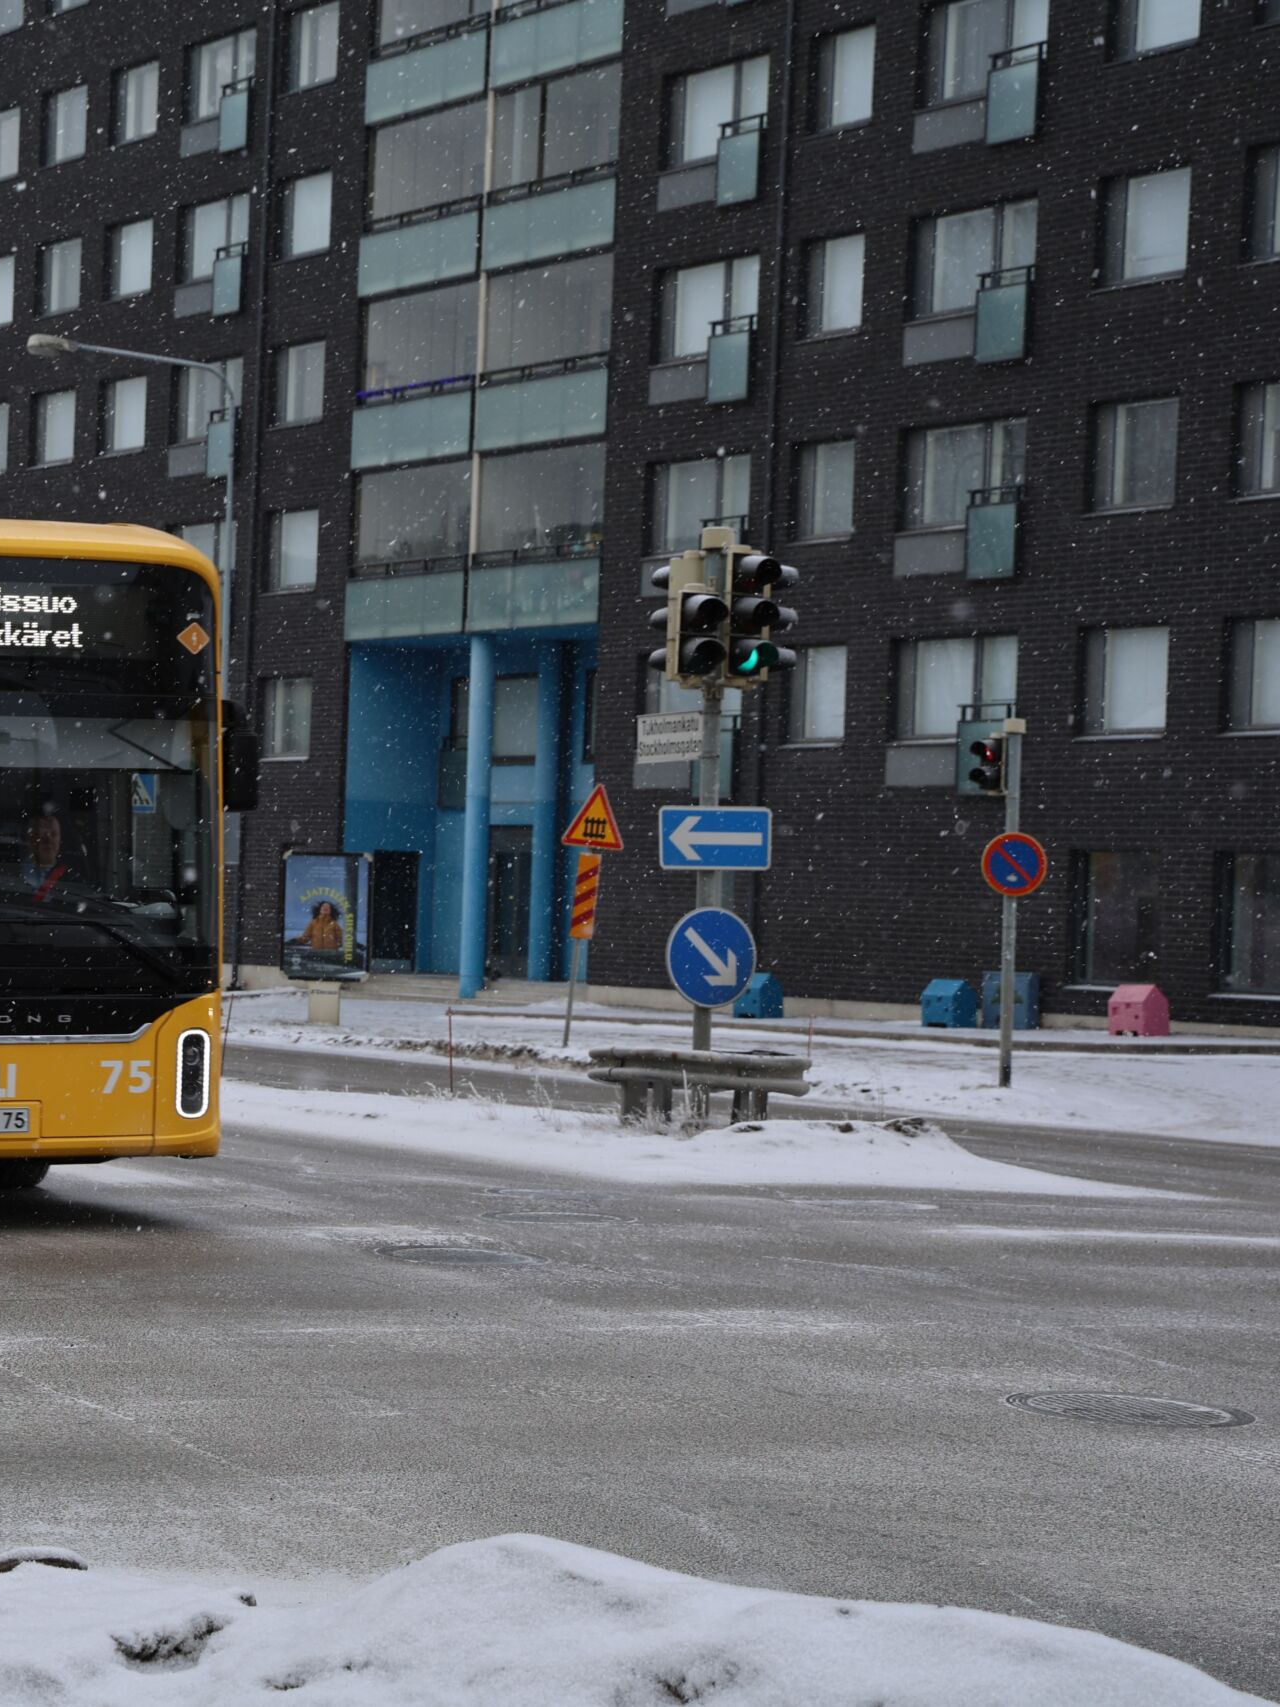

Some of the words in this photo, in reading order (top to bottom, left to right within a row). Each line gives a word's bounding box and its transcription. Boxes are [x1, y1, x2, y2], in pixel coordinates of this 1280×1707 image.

[641, 716, 699, 736] Tukholmankatu
[639, 739, 703, 757] Stockholmsgatan
[100, 1060, 152, 1095] 75
